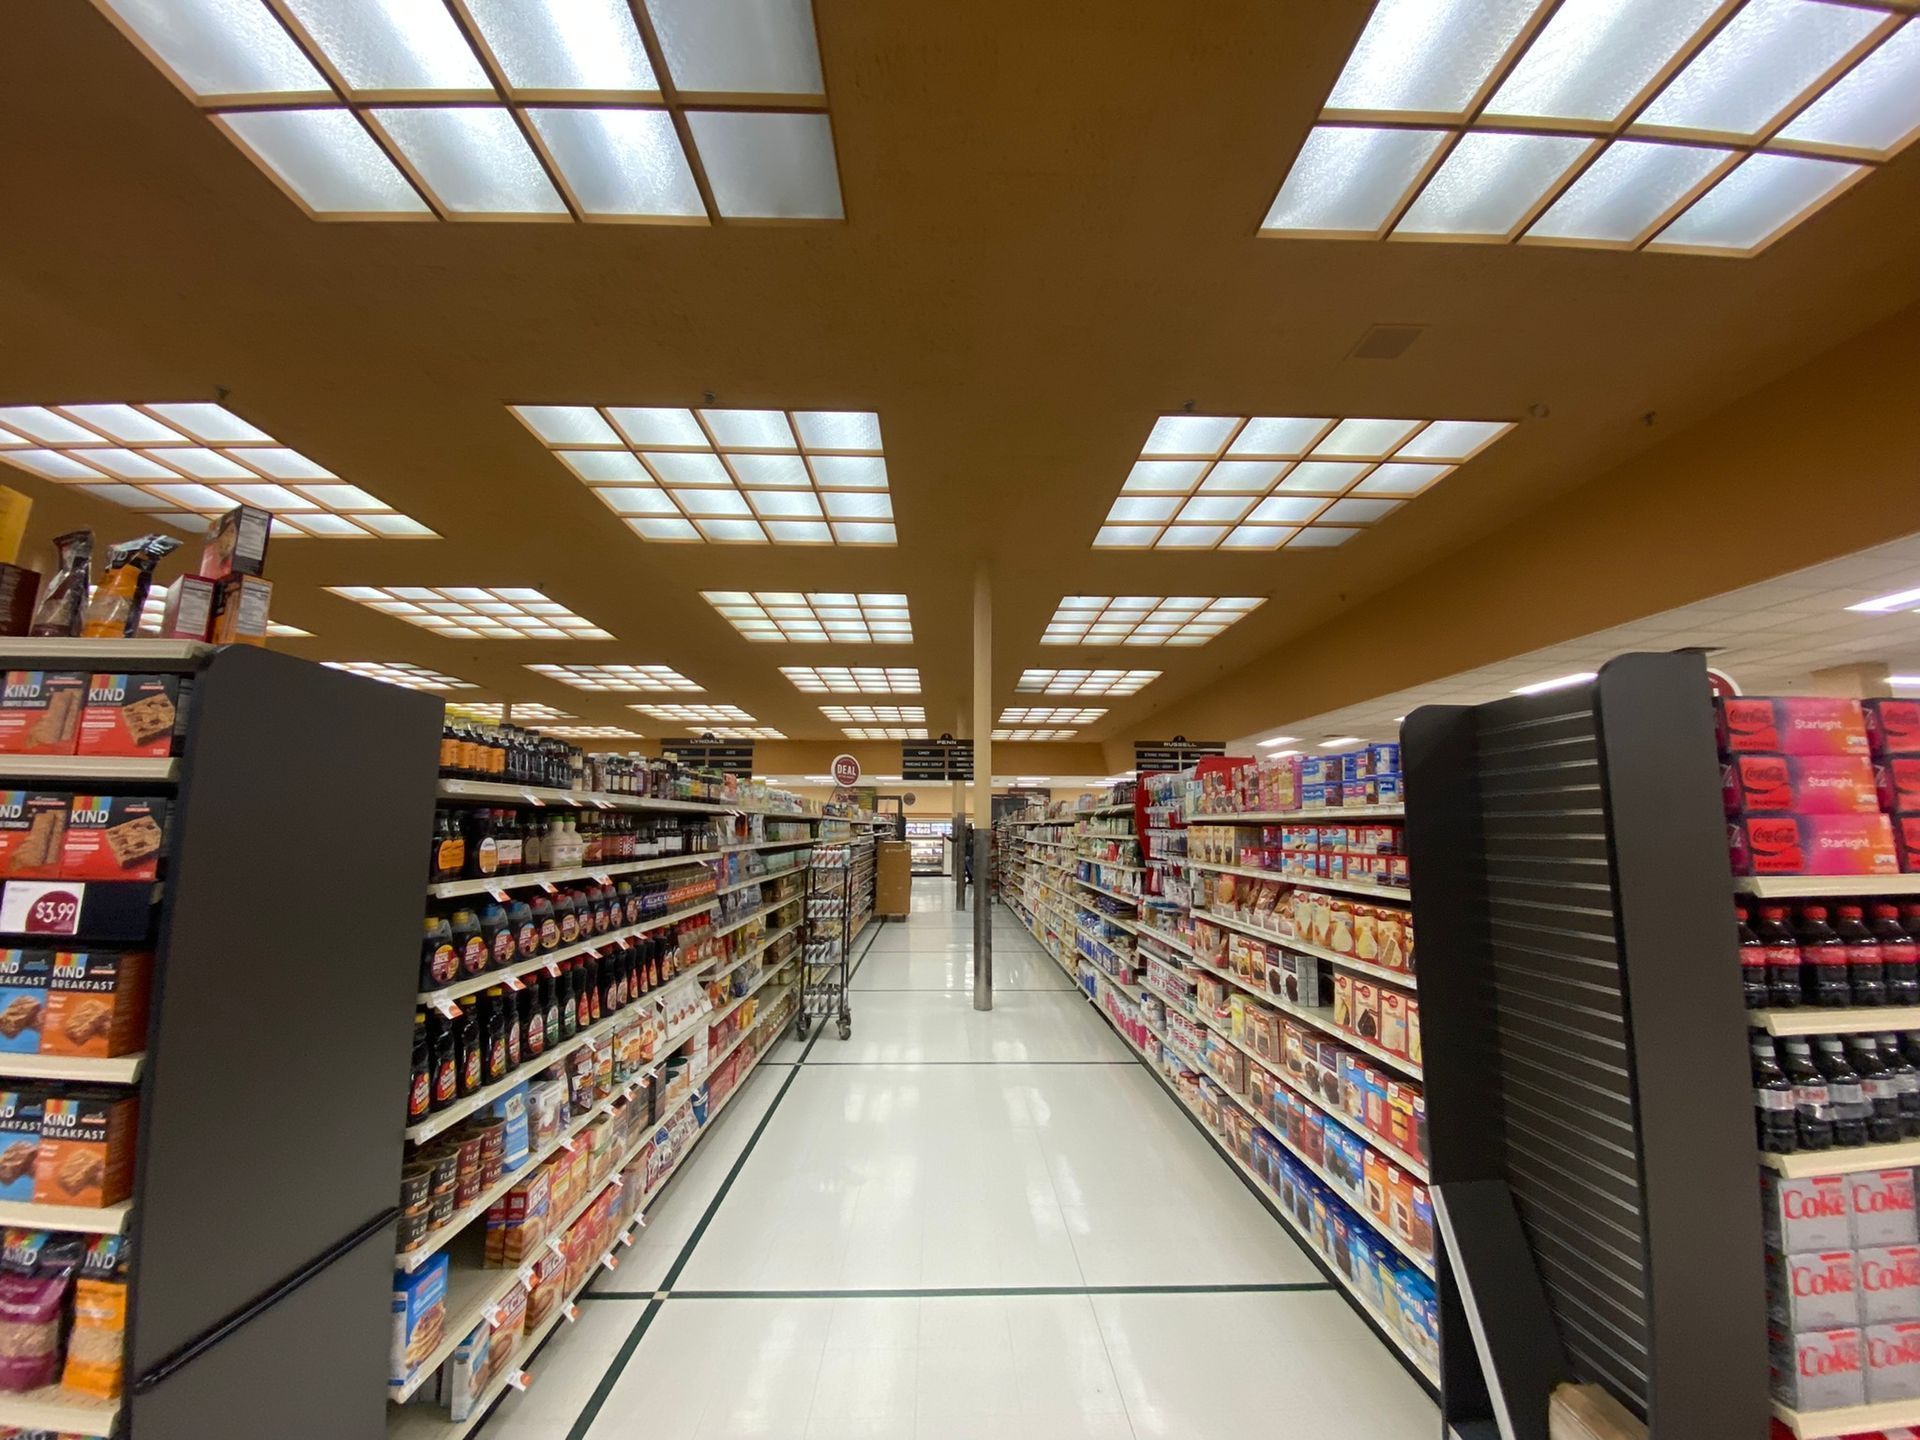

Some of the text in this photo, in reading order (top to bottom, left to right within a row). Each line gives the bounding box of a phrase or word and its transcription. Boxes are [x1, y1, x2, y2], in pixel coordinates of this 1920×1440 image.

[5, 684, 40, 698] KIND
[88, 688, 125, 701] KIND
[1794, 719, 1842, 731] Starlight
[837, 764, 856, 776] DEAL
[1808, 777, 1853, 789] Starlight
[0, 805, 22, 818] ND
[70, 810, 109, 823] KIND
[1753, 828, 1796, 843] Coca-Cola
[1820, 838, 1870, 850] Starlight
[35, 901, 76, 923] $3.99
[0, 962, 19, 974] ND
[52, 966, 85, 979] KIND
[0, 976, 47, 986] EAKFAST
[50, 979, 115, 990] BREAKFAST
[0, 1105, 15, 1118] ND
[0, 1120, 42, 1131] AKFAST
[43, 1112, 76, 1127] KIND
[42, 1126, 106, 1140] BREAKFAST
[1783, 1189, 1846, 1219] Coke
[1852, 1183, 1915, 1213] Coke
[84, 1251, 116, 1270] IND
[1792, 1265, 1855, 1298] Coke
[1867, 1337, 1920, 1369] Cok
[1799, 1346, 1862, 1378] Coke
